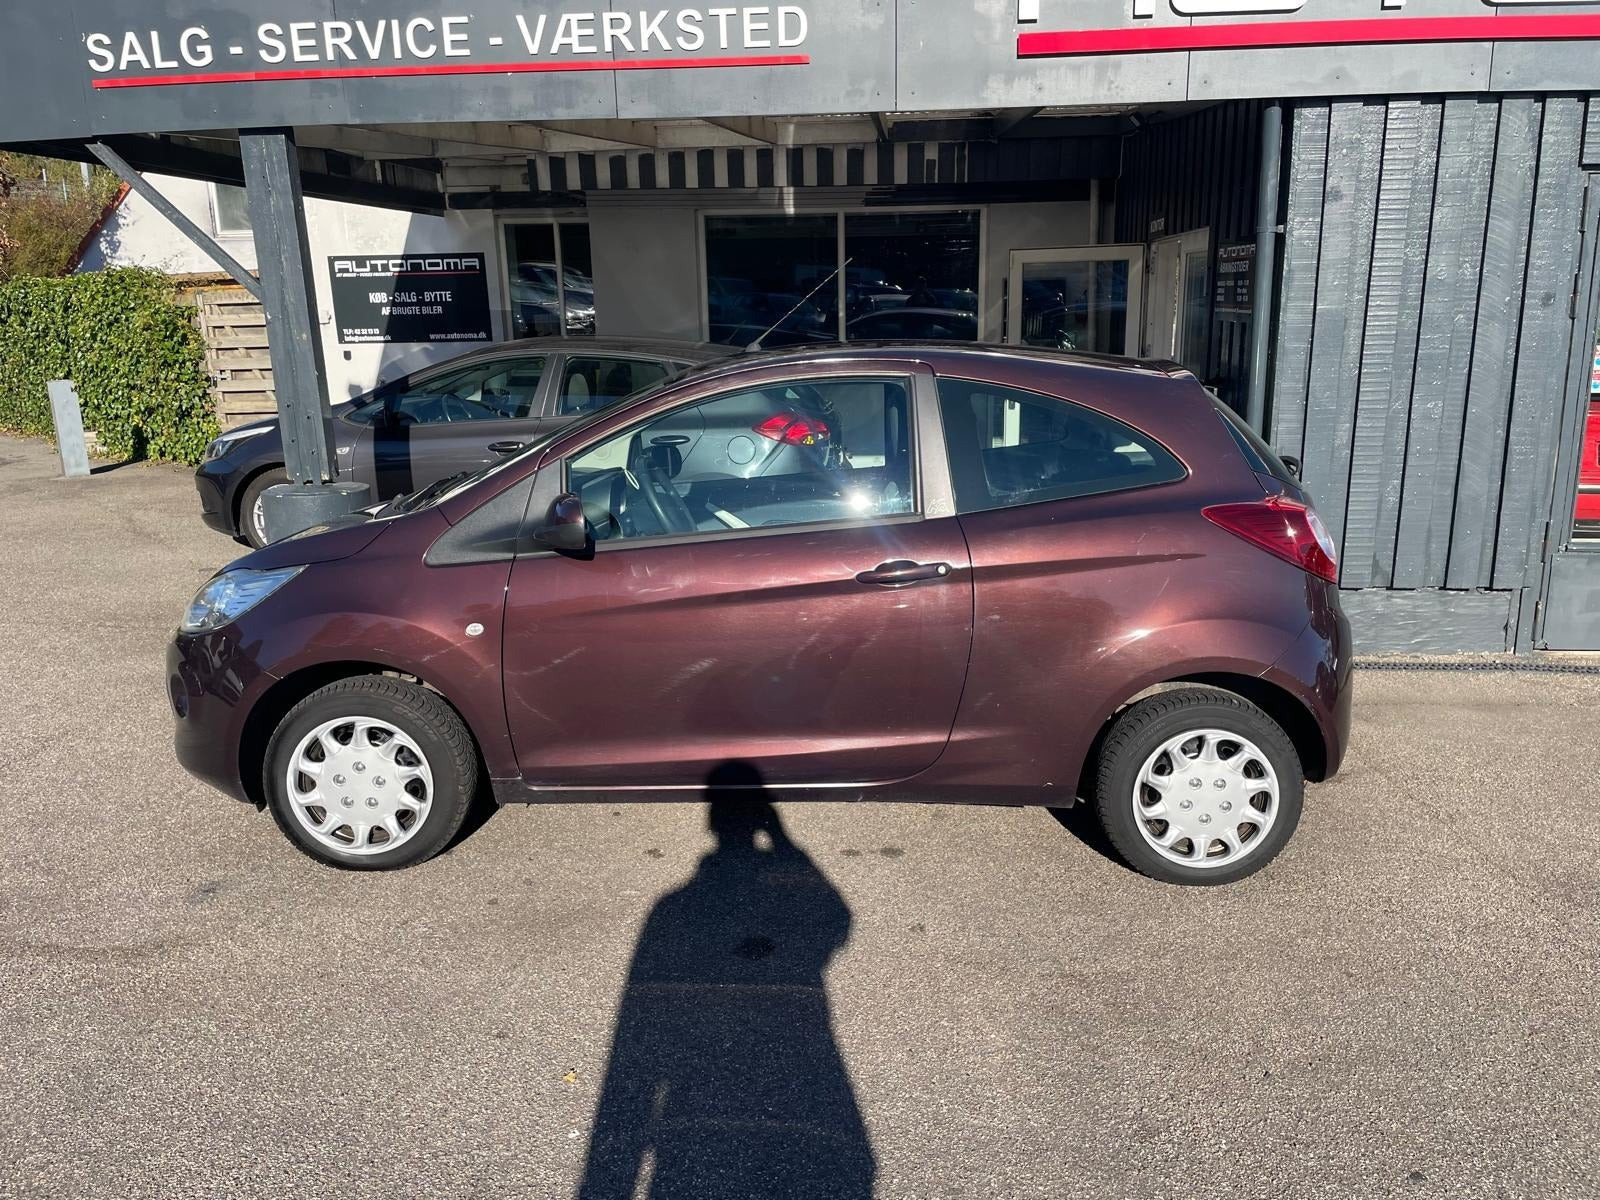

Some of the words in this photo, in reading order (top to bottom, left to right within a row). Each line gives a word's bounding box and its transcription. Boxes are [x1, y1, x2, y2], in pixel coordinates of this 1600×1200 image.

[87, 27, 214, 73] SALG
[257, 15, 471, 64] SERVICE
[515, 5, 809, 56] VÆRKSTED
[334, 258, 480, 272] AUTONOMA
[368, 292, 388, 304] KØB
[394, 292, 417, 303] SALG
[424, 291, 452, 302] BYTTE
[381, 306, 391, 316] AF
[392, 306, 421, 315] BRUGTE
[421, 305, 443, 315] BILER
[429, 332, 487, 340] www.autonoma.dk
